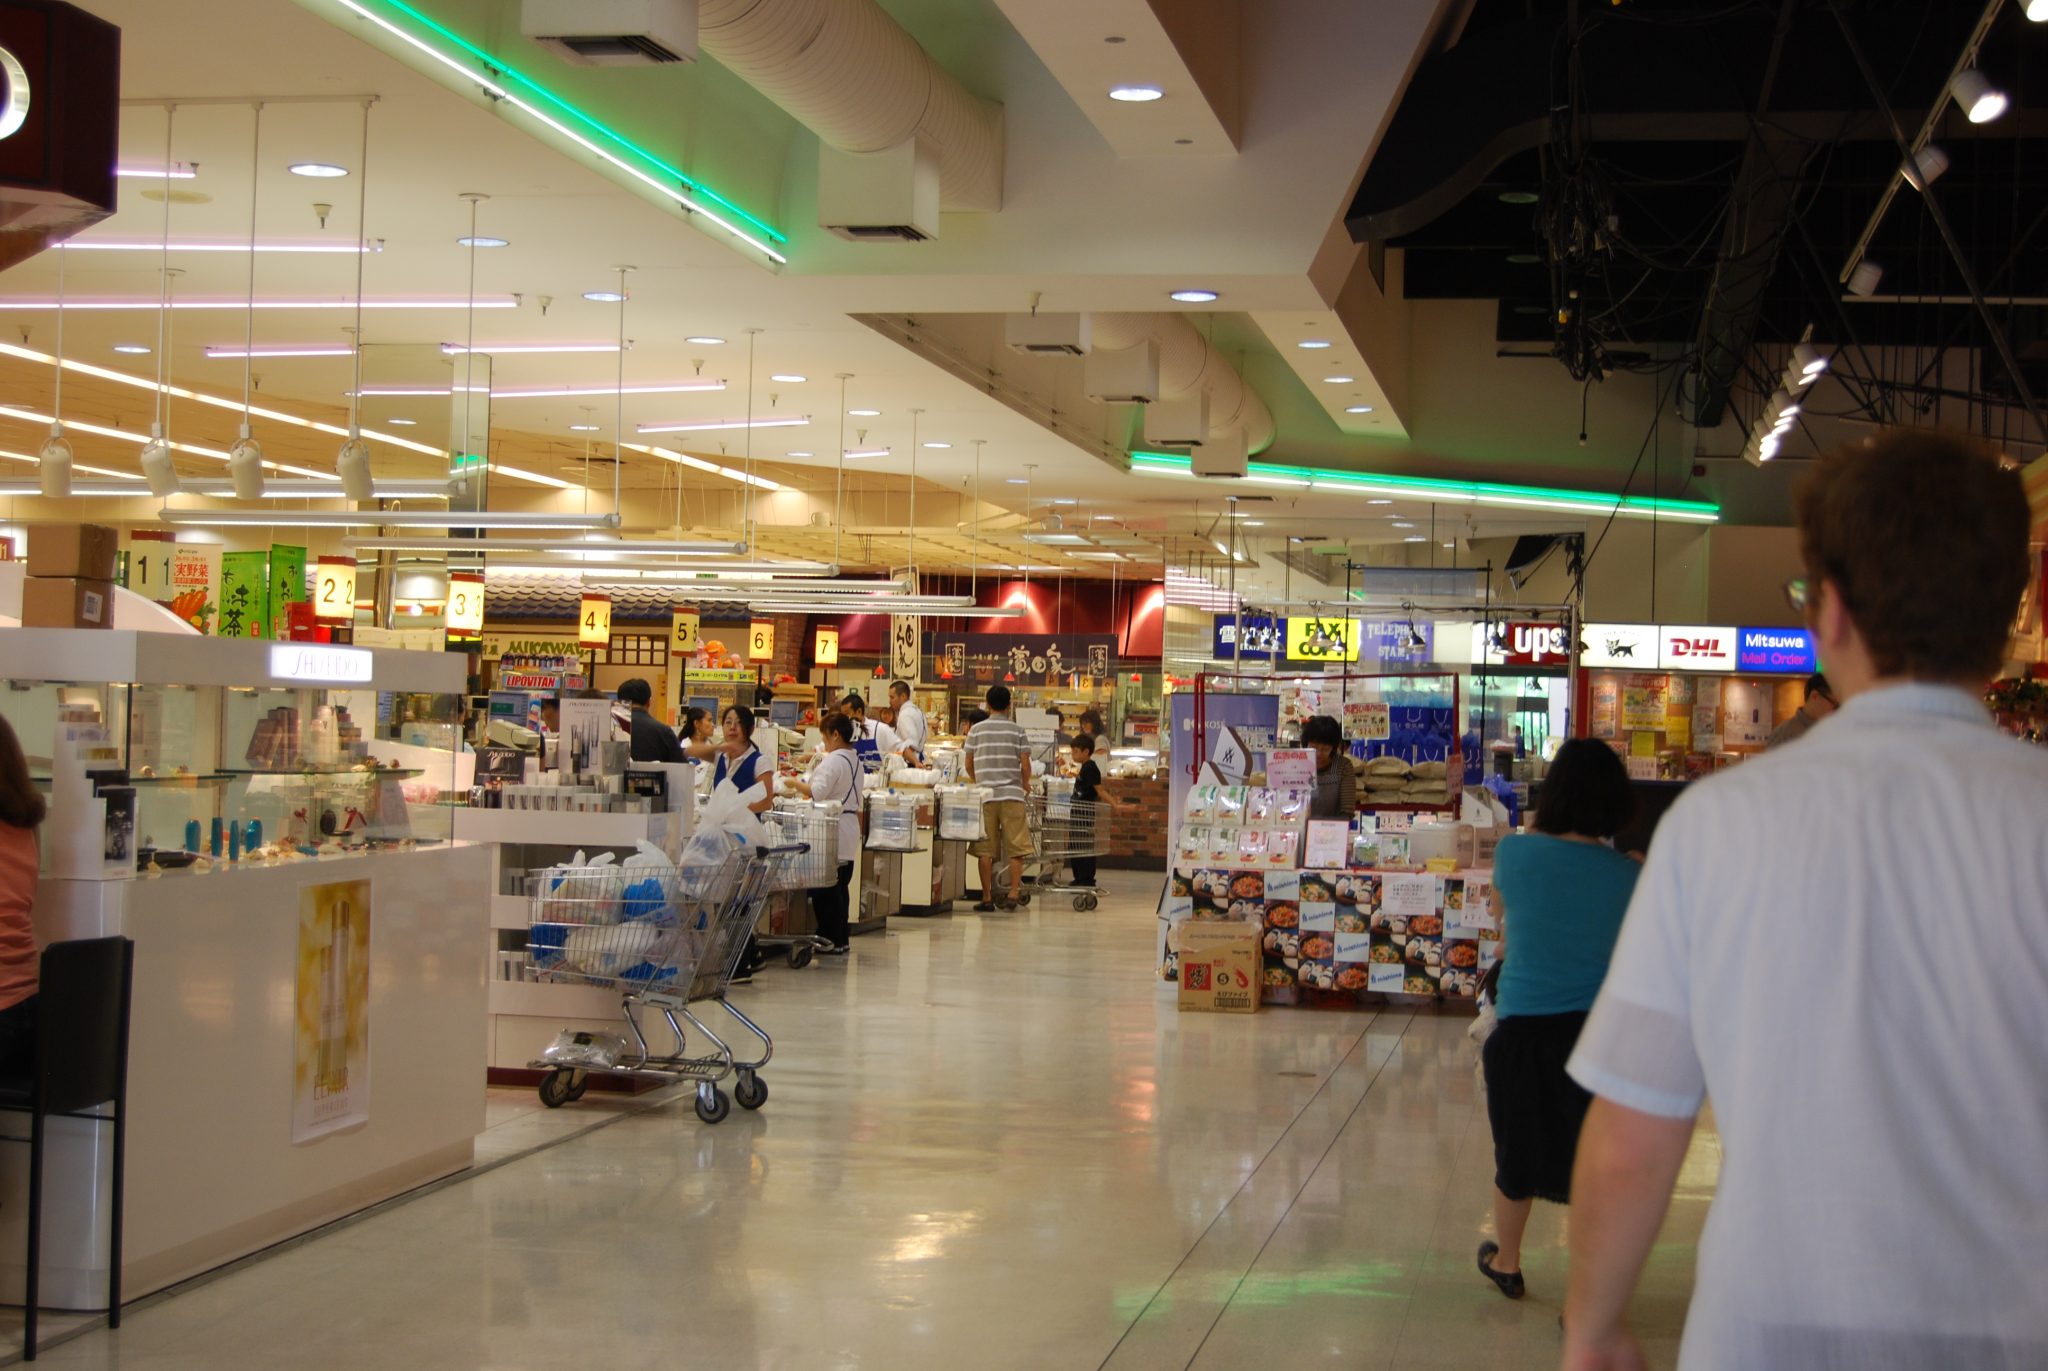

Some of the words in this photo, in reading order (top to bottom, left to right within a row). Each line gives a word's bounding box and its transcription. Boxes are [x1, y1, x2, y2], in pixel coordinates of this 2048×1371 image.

[138, 556, 147, 585] 1
[163, 557, 169, 586] 1
[174, 562, 208, 577] 実野菜
[323, 578, 336, 603] 2
[346, 580, 352, 605] 2
[455, 594, 466, 616] 3
[475, 595, 481, 617] 3
[585, 611, 596, 631] 4
[603, 612, 608, 632] 4
[1305, 622, 1340, 637] FAX
[677, 623, 687, 641] 5
[693, 624, 698, 642] 5
[1367, 623, 1427, 639] TELEPHNE
[1745, 633, 1804, 648] Mitsuwa
[754, 633, 764, 650] 6
[820, 640, 829, 654] 7
[1515, 627, 1565, 662] ups
[1670, 638, 1726, 658] DHL
[1742, 652, 1766, 665] Mail
[1771, 653, 1806, 665] Order
[507, 675, 556, 688] LIPOVITAN
